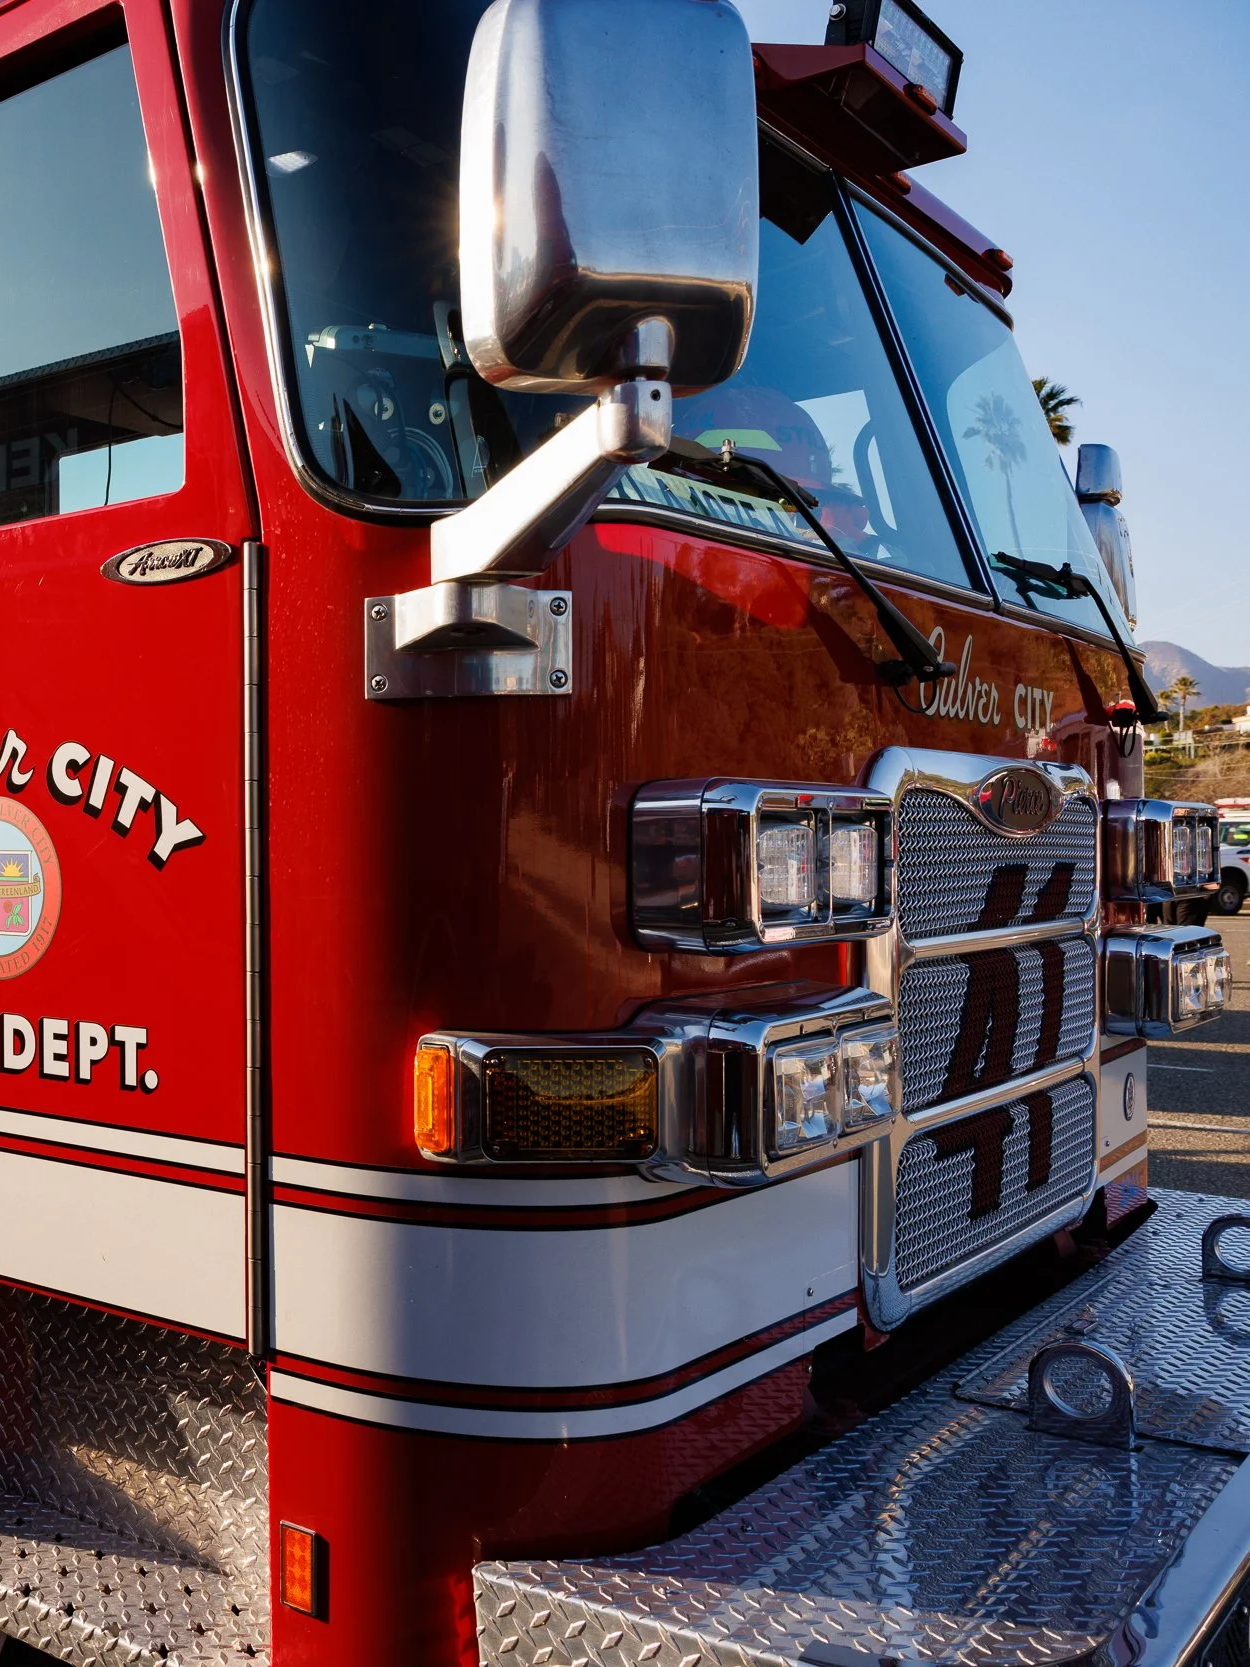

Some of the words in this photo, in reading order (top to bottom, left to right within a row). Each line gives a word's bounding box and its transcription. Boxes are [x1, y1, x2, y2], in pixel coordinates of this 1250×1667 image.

[920, 626, 1002, 725] Culver
[1013, 683, 1054, 733] CITY
[47, 741, 206, 870] CITY
[30, 827, 55, 866] CITY
[33, 918, 54, 953] 1917
[0, 1013, 160, 1093] DEPT.
